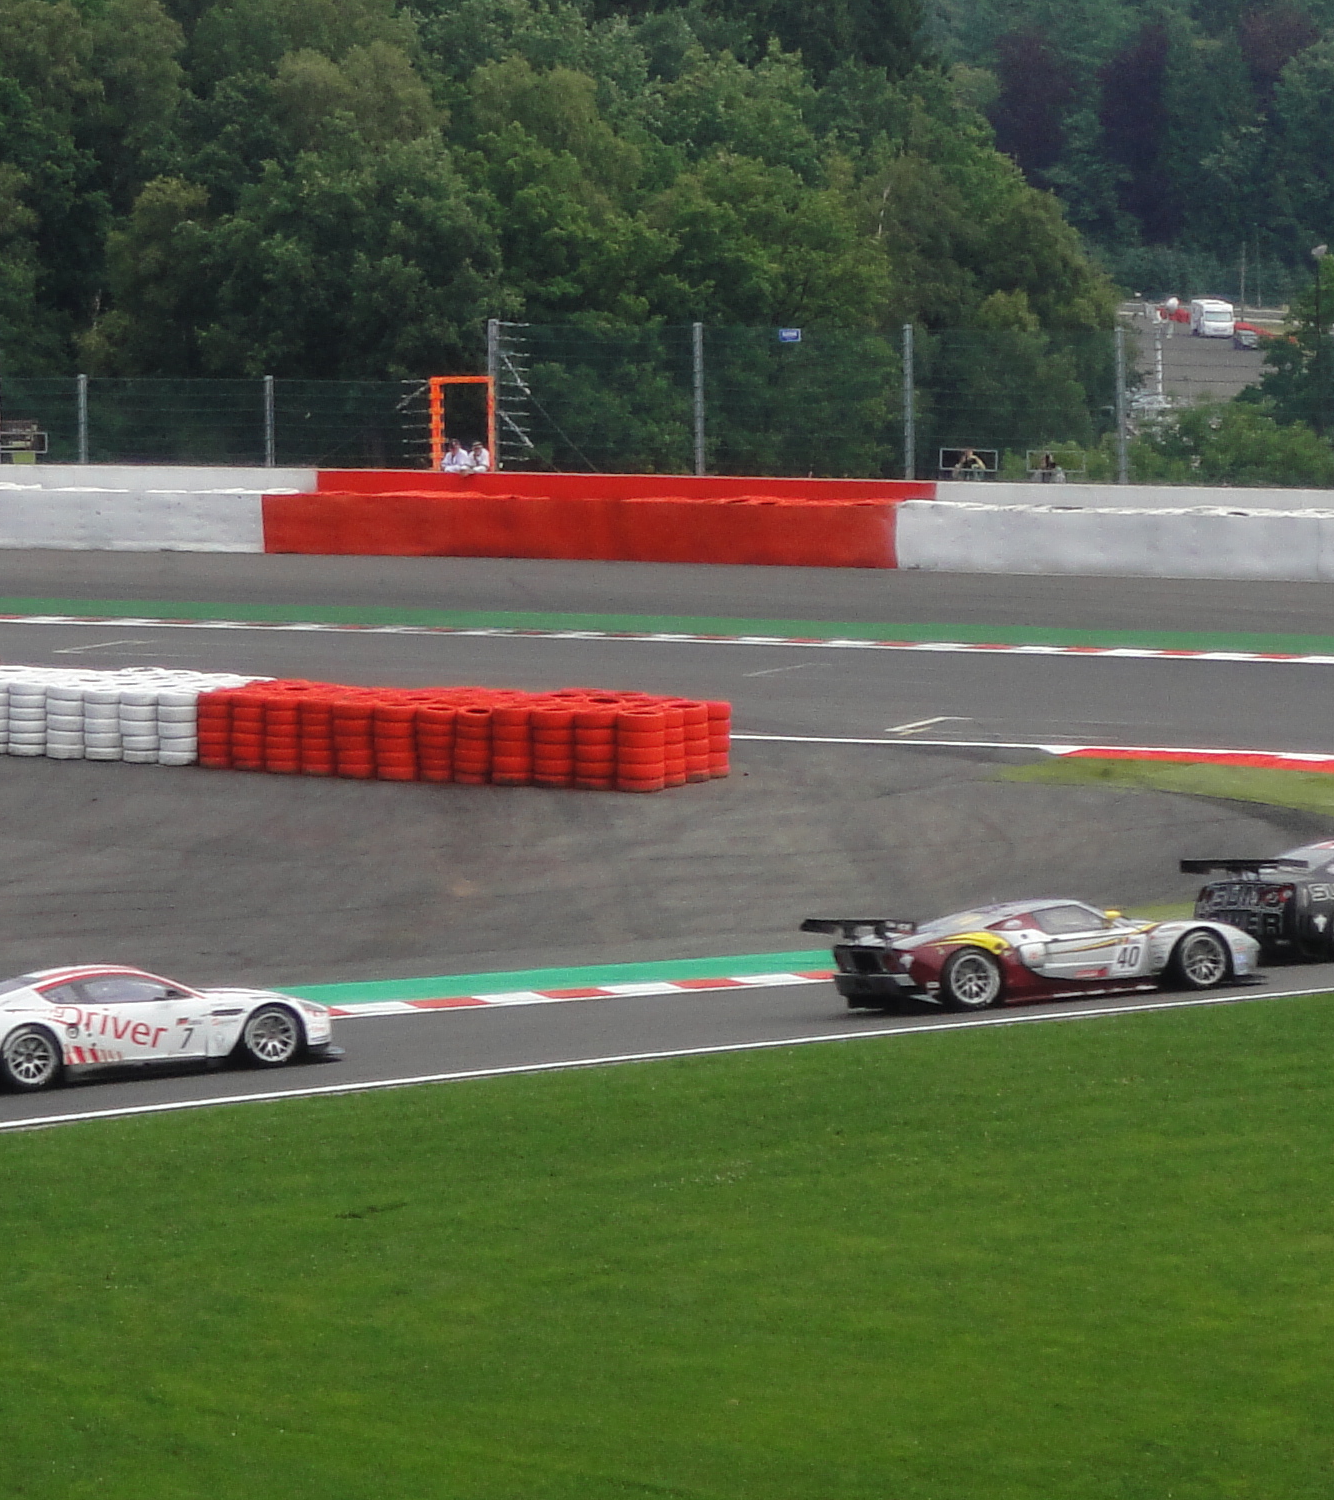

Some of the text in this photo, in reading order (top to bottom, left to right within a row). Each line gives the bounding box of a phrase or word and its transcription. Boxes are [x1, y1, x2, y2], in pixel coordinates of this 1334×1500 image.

[1117, 946, 1141, 969] 40
[47, 1005, 169, 1049] Driver
[180, 1027, 194, 1049] 7
